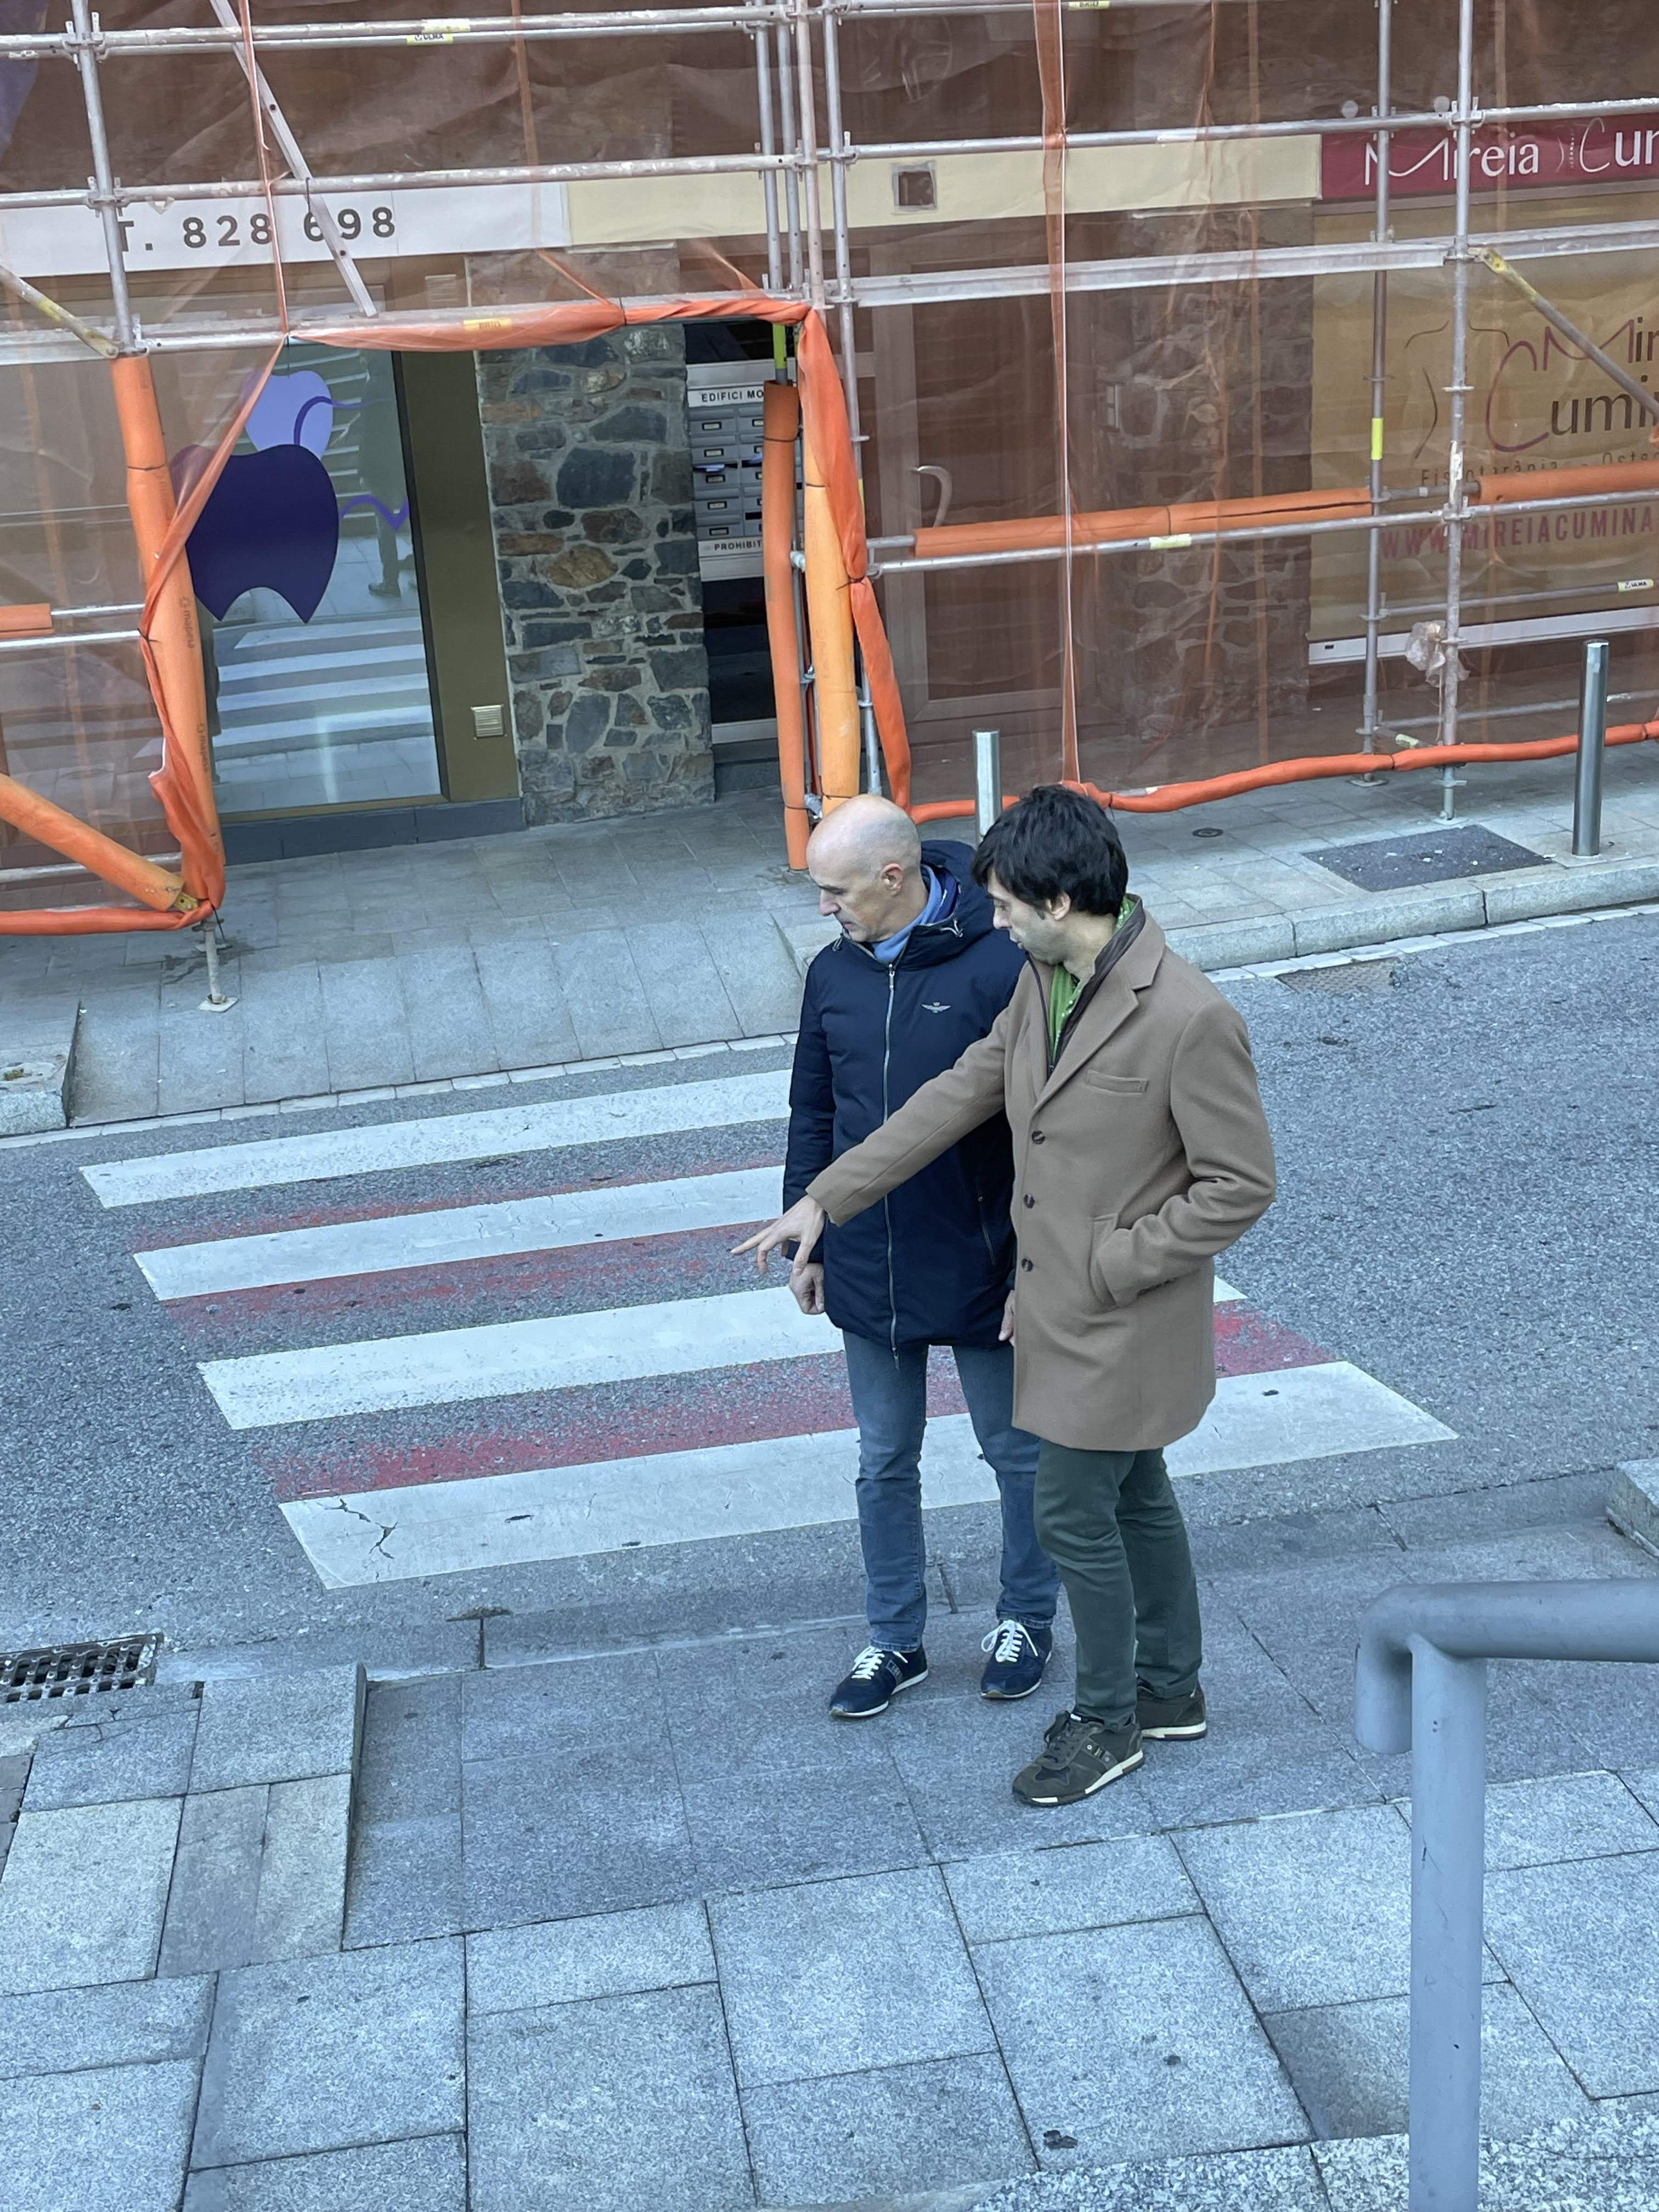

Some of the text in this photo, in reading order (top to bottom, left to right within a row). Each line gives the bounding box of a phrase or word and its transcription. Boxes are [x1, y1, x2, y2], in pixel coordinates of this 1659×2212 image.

[118, 207, 395, 251] T. 828 698
[701, 390, 764, 403] EDIFICI MO
[1485, 340, 1659, 453] Cumi
[1381, 506, 1653, 558] WWWMIREIACUMINA
